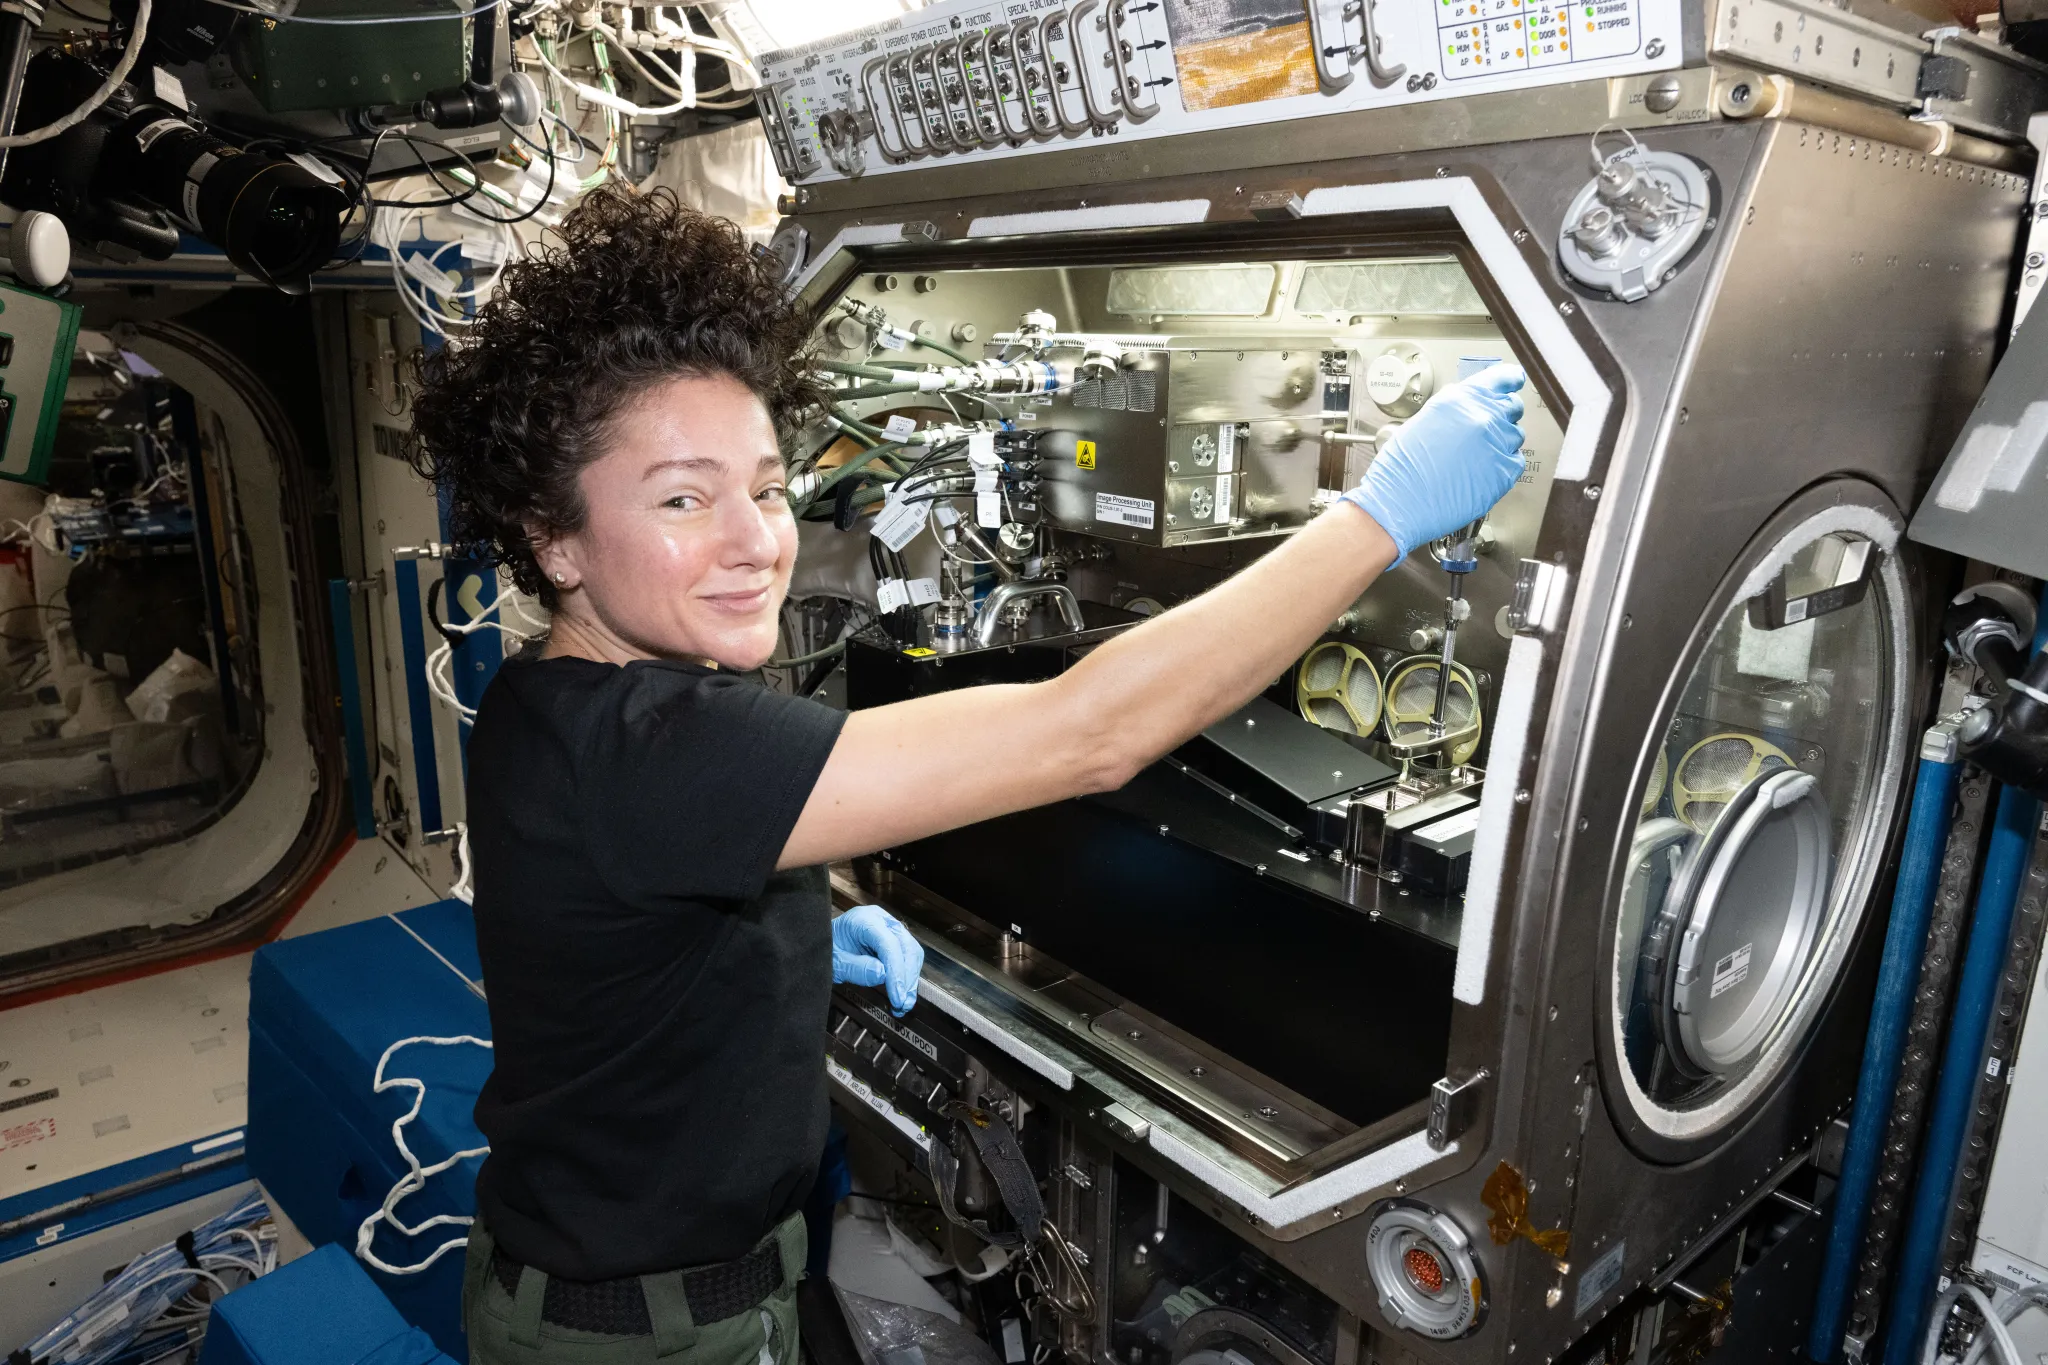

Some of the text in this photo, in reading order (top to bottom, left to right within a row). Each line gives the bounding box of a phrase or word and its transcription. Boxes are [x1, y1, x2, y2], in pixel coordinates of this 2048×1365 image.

[1007, 0, 1058, 16] SPECIAL FUNCTIONS
[1597, 3, 1627, 14] RUNNING
[965, 12, 992, 28] FUNCTIONS
[1598, 17, 1630, 30] STOPPED
[194, 25, 214, 40] Nikon
[1496, 23, 1509, 32] GAS
[885, 34, 910, 48] EXPERIMENT
[910, 31, 926, 42] POWER
[928, 24, 948, 38] OUTLETS
[1456, 30, 1468, 40] GAS
[1539, 30, 1556, 40] DOOR
[761, 17, 902, 65] COMMAND AND MONITORING PANEL (CMP)
[1456, 44, 1470, 53] HUM
[1544, 44, 1554, 54] LID
[825, 54, 836, 63] TEST
[800, 76, 816, 87] STATUS
[1629, 94, 1646, 104] LOC
[1676, 109, 1707, 120] UNLOCK
[1524, 460, 1542, 473] ENT
[1097, 494, 1152, 509] Image Processing Unit
[894, 1023, 911, 1040] BOX
[912, 1035, 933, 1056] (PDC)
[835, 1068, 844, 1078] FAN
[850, 1081, 866, 1096] AIRLOCK
[916, 1133, 926, 1143] CMP
[1368, 1225, 1381, 1244] J403
[2007, 1264, 2024, 1276] FCF
[1430, 1328, 1450, 1336] 14981
